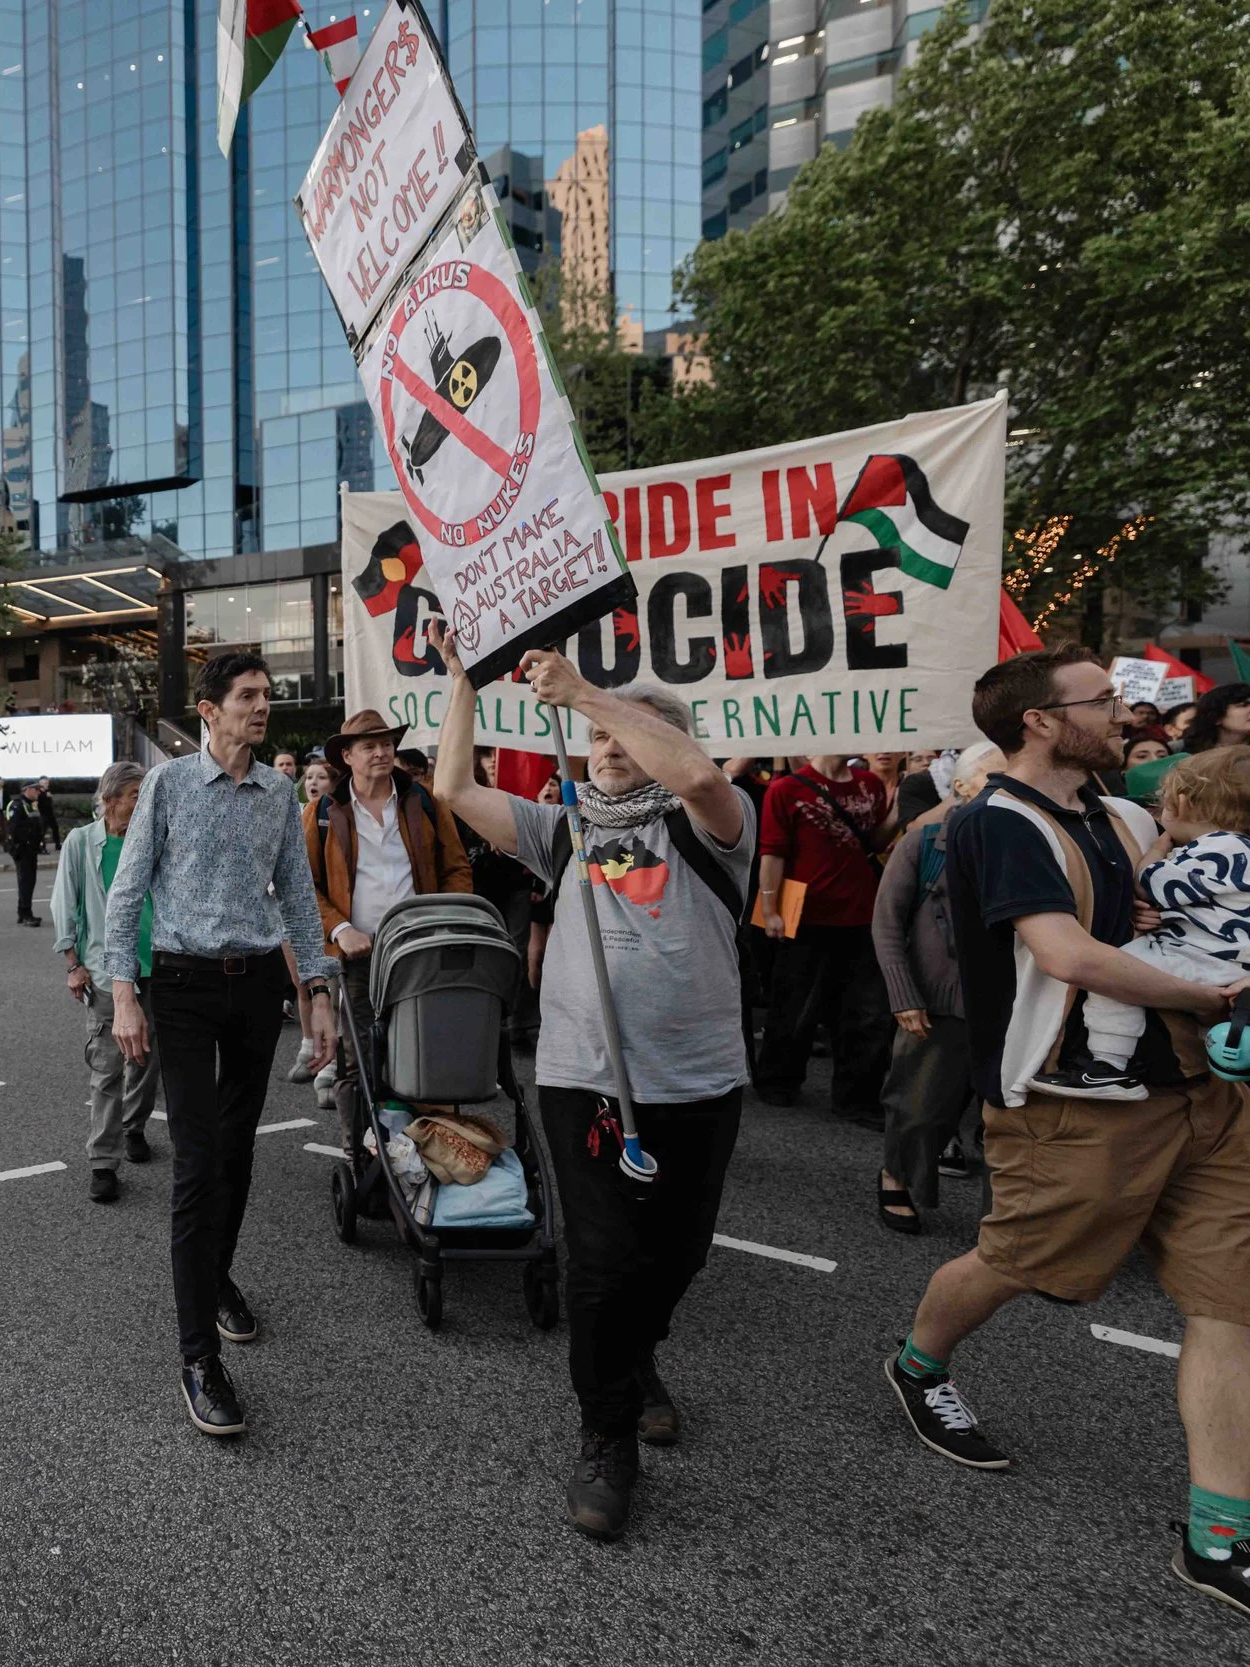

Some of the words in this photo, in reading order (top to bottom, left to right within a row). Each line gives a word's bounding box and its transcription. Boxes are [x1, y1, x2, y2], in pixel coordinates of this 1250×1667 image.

[350, 139, 388, 233] NOT
[382, 331, 399, 381] NO
[402, 261, 472, 321] AUKUS
[440, 522, 466, 546] NO
[476, 432, 536, 537] NUKES
[762, 462, 838, 543] IN
[454, 542, 499, 595] DON'T
[502, 498, 565, 561] MAKE
[475, 529, 582, 616] AUSTRALIA
[498, 608, 516, 635] A
[511, 528, 608, 619] TARGET!!
[392, 546, 908, 688] GOCIDE
[6, 739, 93, 755] WILLIAM
[389, 690, 573, 739] SOCALIST
[692, 688, 918, 738] ERNATIVE
